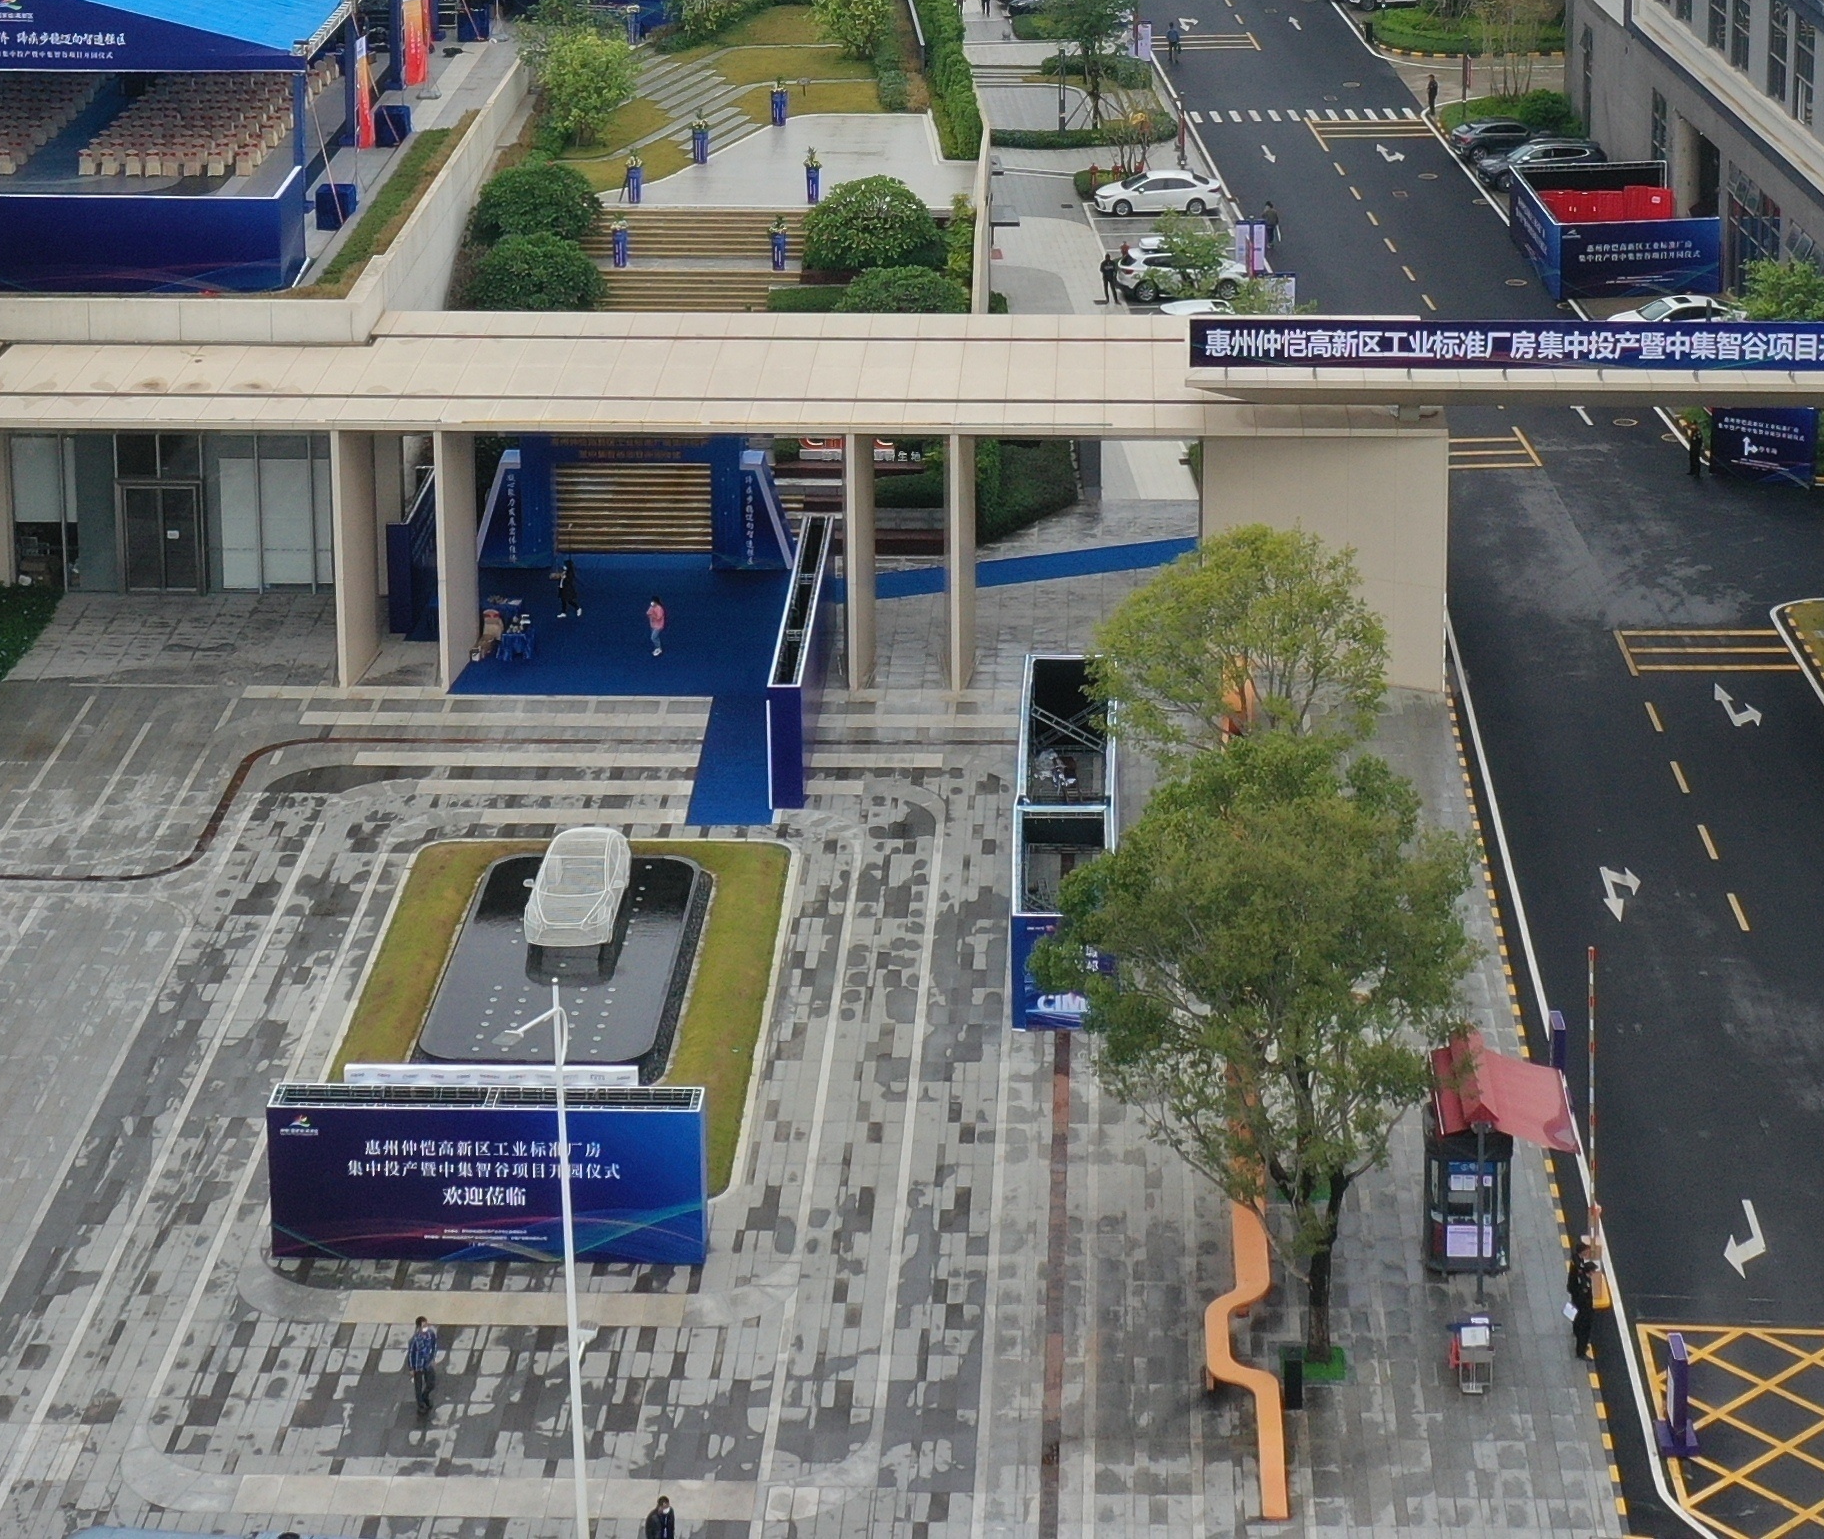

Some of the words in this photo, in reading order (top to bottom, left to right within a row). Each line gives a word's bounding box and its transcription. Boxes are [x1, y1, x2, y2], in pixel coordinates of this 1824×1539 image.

[364, 1138, 602, 1159] 惠州仲恺高新区工业标准厂房
[442, 1185, 527, 1207] 欢迎莅临
